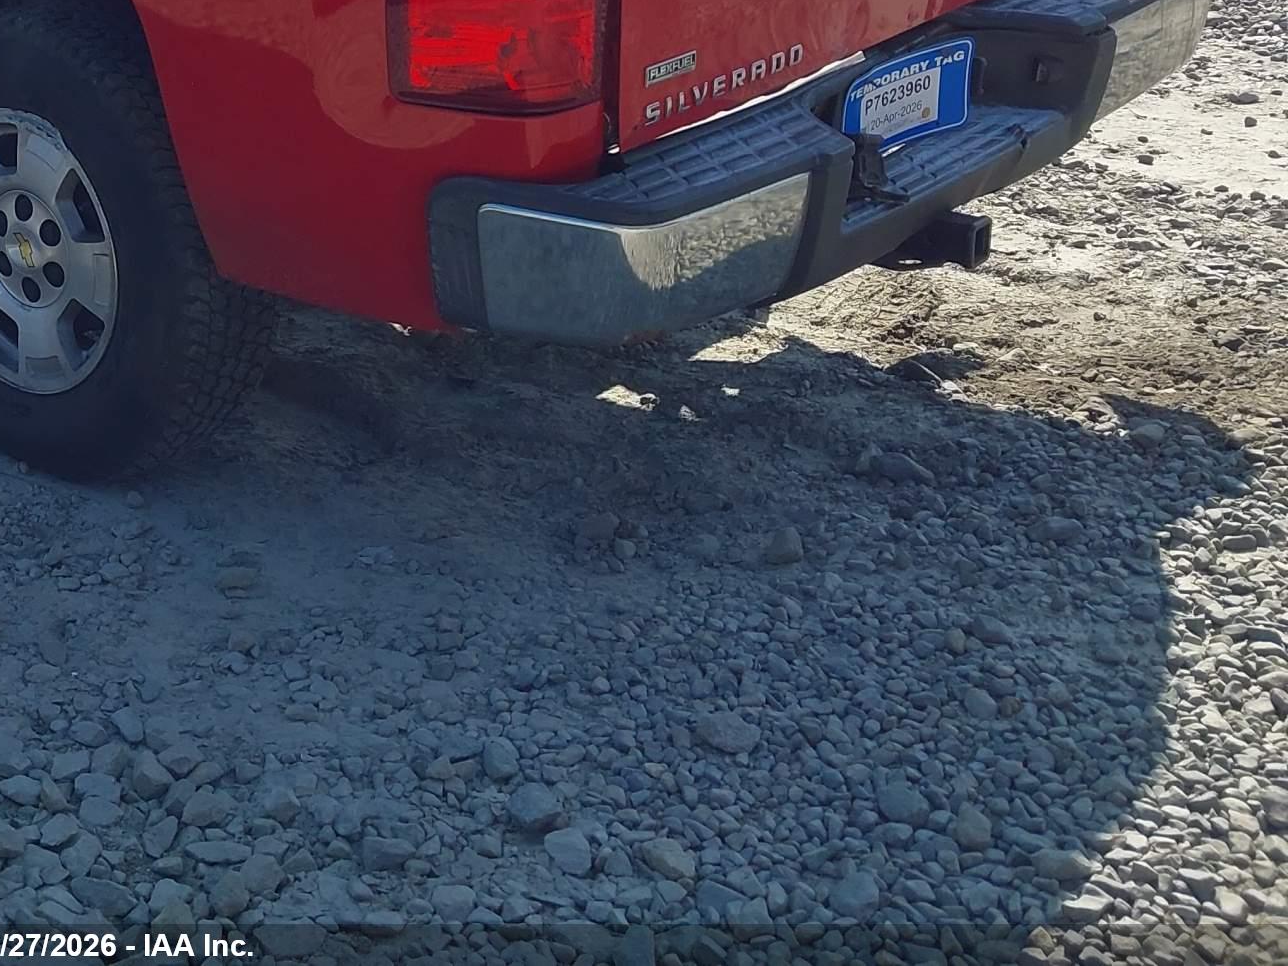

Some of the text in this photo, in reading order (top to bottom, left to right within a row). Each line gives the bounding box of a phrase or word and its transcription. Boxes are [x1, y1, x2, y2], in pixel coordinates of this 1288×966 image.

[648, 53, 696, 82] FLEXFUEL
[934, 50, 965, 68] TAG
[644, 43, 804, 127] SILVERADO
[864, 74, 931, 116] P7623960
[870, 99, 923, 131] 20-Apr-2026
